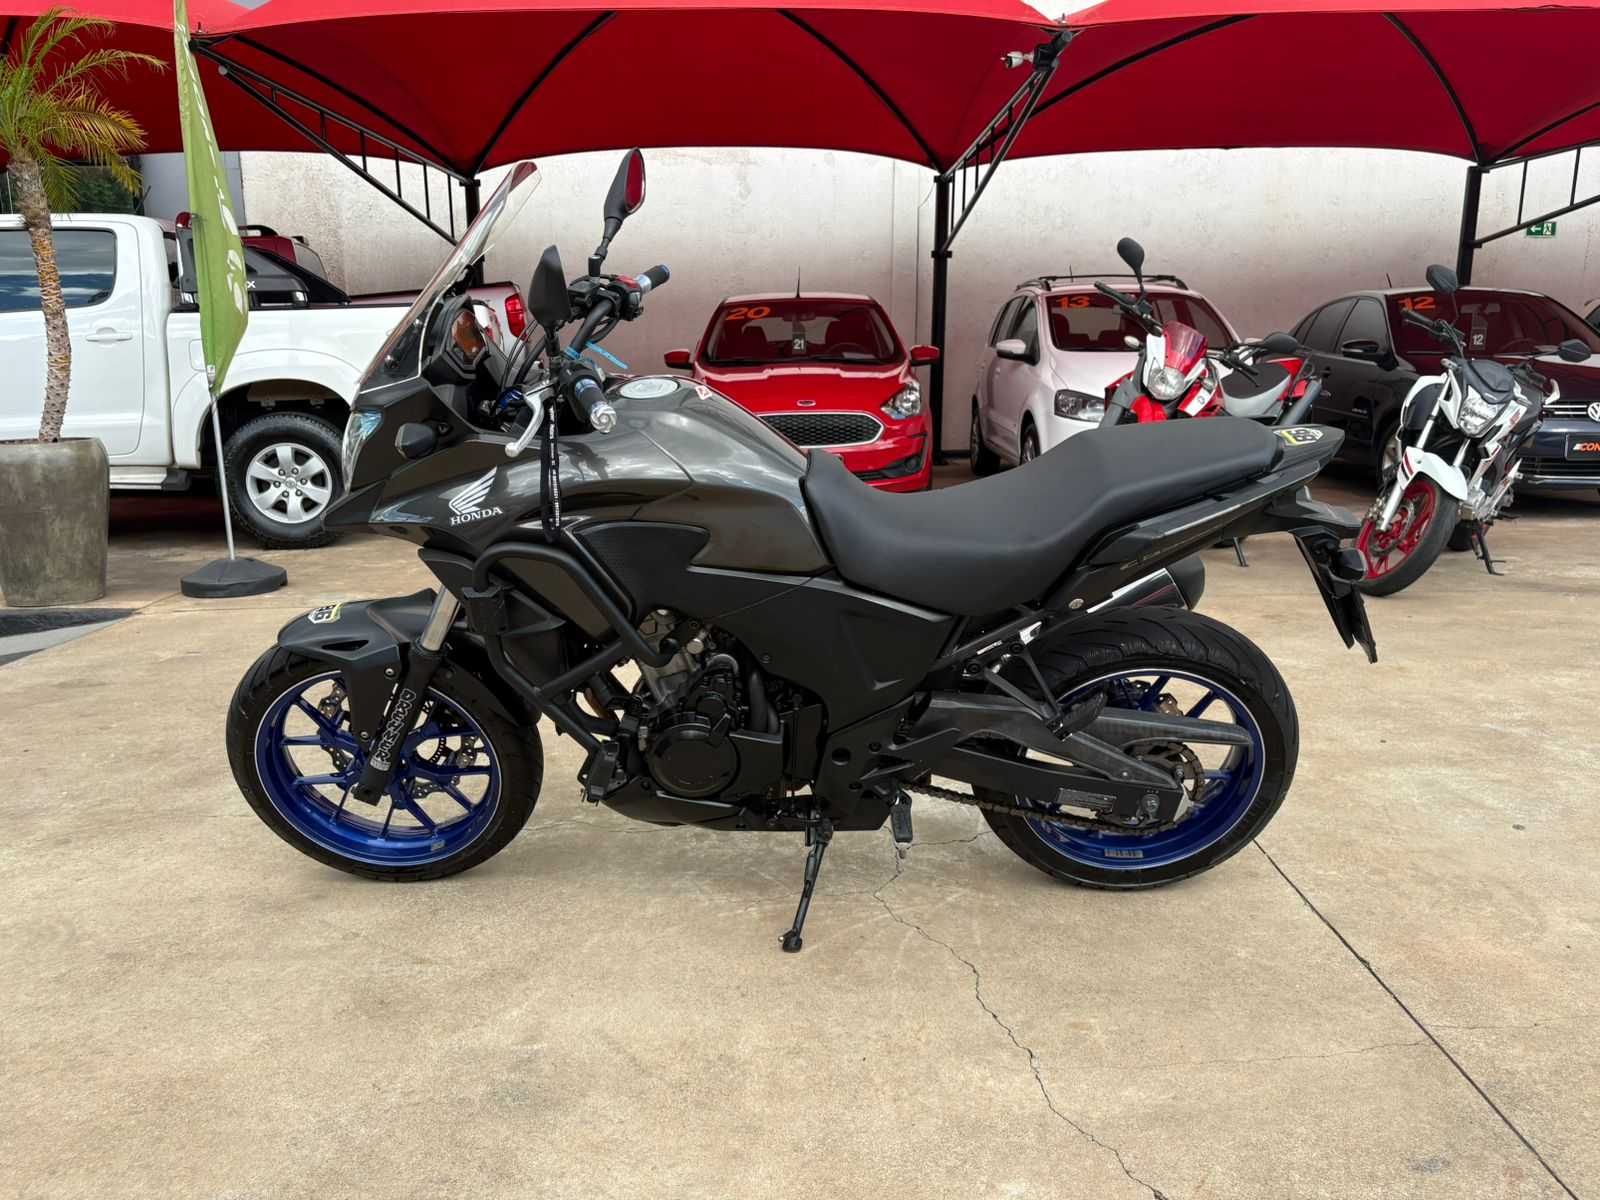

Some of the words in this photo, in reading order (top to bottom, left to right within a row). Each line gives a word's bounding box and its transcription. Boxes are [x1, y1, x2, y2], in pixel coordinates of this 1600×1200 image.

[1056, 296, 1089, 309] 13
[1398, 296, 1436, 311] 12
[725, 306, 771, 320] 20
[793, 339, 805, 350] 21
[1473, 334, 1484, 345] 12
[450, 506, 504, 526] HONDA
